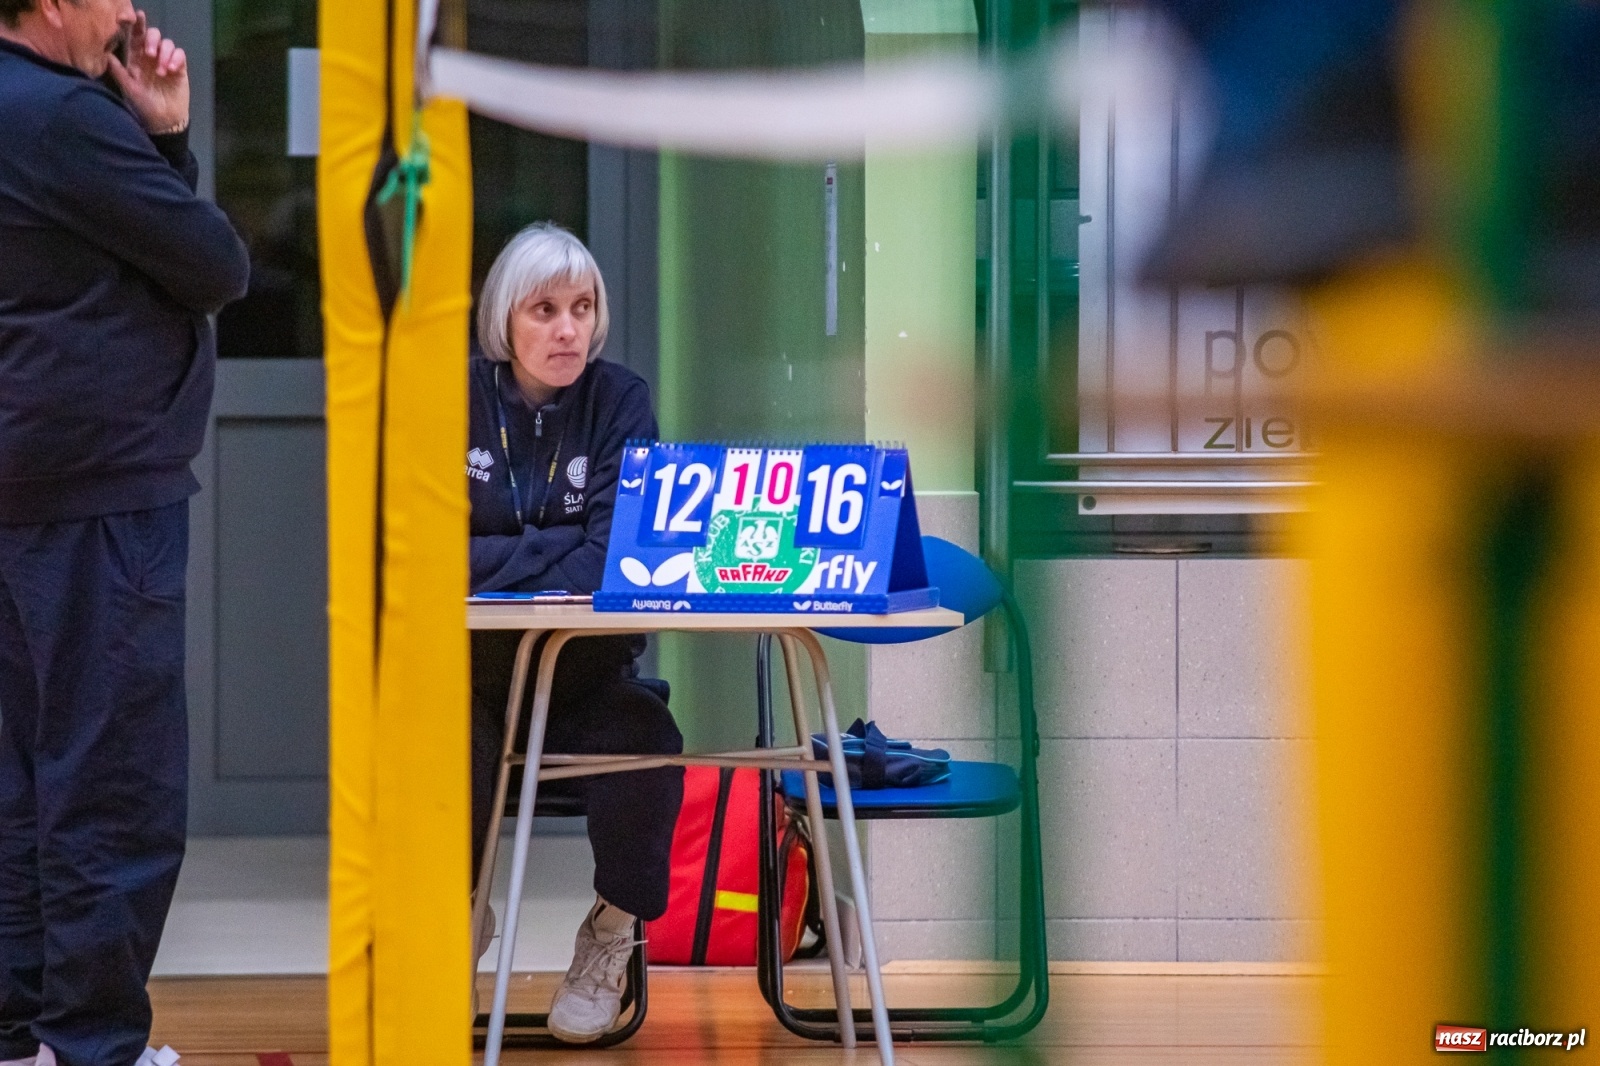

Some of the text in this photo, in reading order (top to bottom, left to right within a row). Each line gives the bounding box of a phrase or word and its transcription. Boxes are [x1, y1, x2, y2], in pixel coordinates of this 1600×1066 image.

[1204, 328, 1311, 398] po
[1203, 416, 1297, 450] zie
[652, 462, 712, 532] 12
[807, 463, 867, 535] 16
[813, 554, 878, 595] rfly
[631, 598, 672, 611] Butterfly
[812, 600, 854, 613] Butterfly
